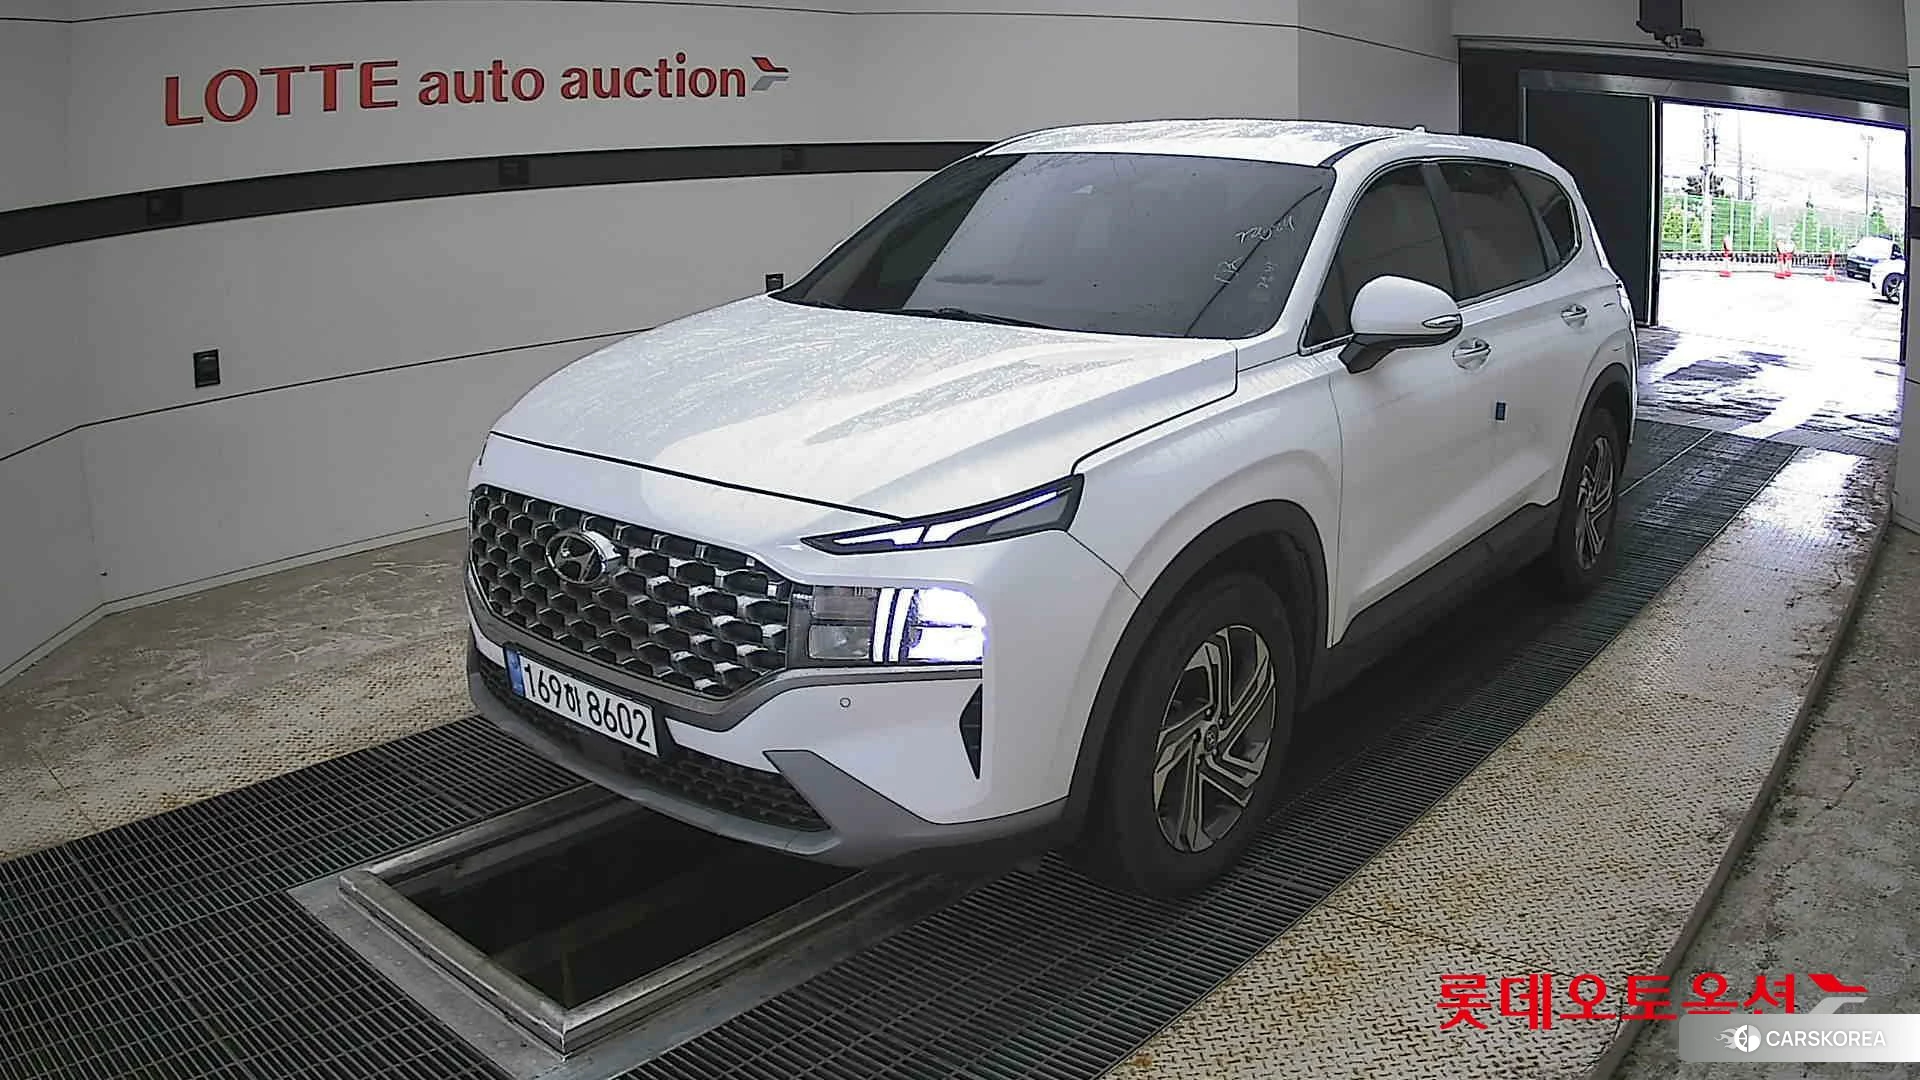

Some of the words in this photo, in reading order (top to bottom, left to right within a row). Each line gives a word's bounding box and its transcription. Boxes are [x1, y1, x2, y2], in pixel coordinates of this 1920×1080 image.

[164, 59, 400, 127] LOTTE
[418, 59, 546, 106] auto
[560, 52, 747, 98] auction
[586, 690, 650, 748] 8602
